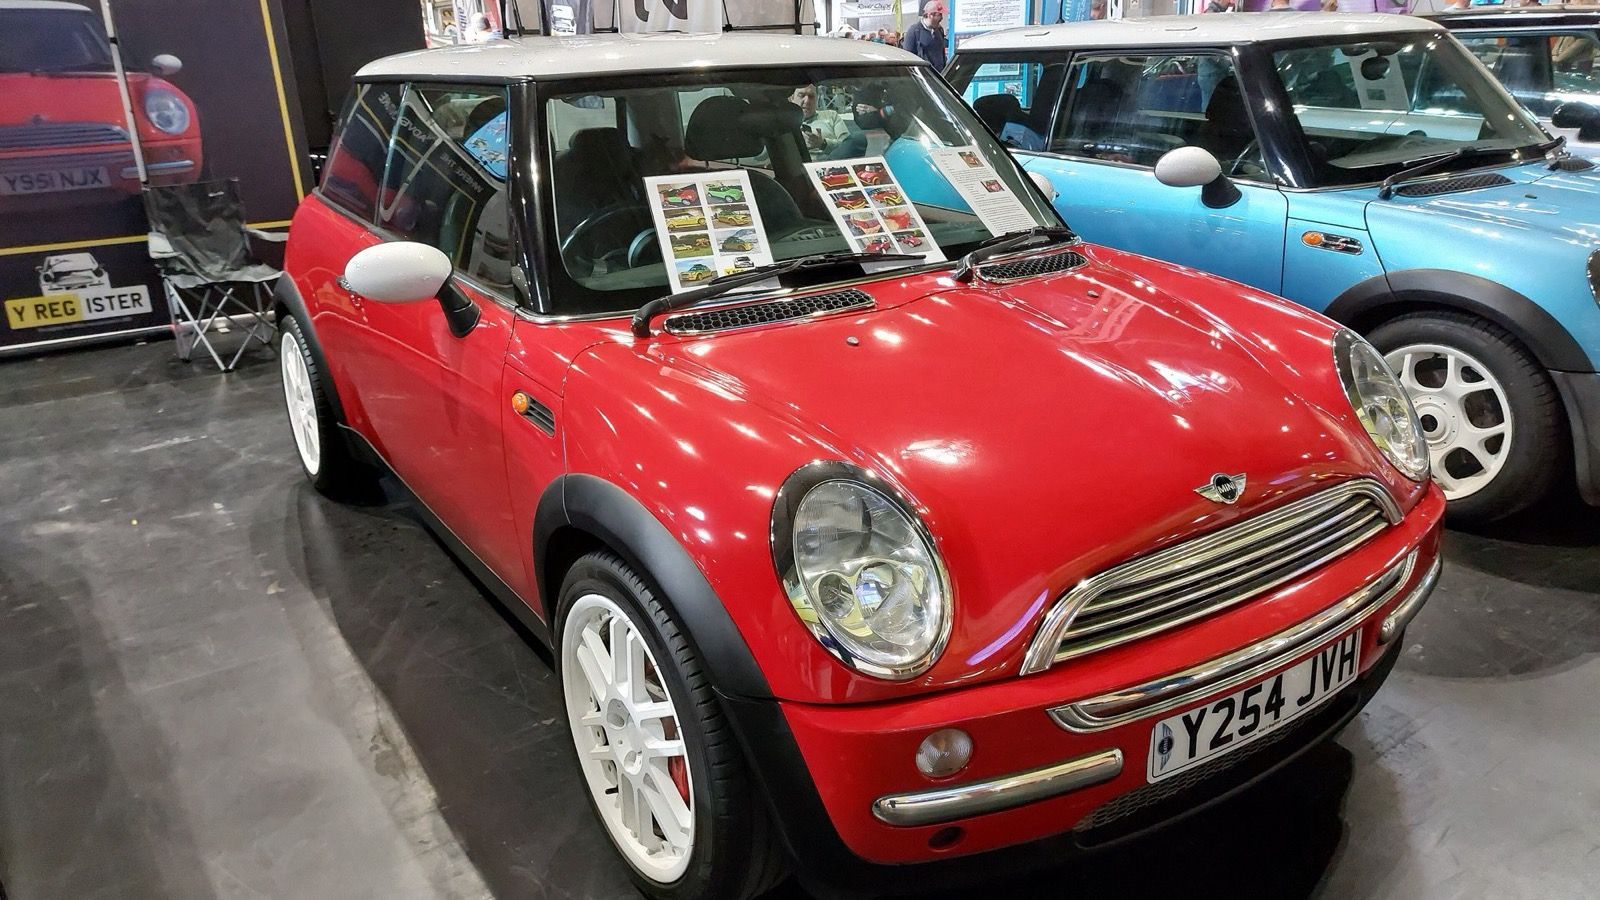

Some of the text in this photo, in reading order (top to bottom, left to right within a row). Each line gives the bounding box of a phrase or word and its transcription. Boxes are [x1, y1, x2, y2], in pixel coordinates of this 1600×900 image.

[12, 306, 25, 322] Y
[1217, 483, 1236, 493] MINI
[1182, 632, 1358, 760] Y254 JVH
